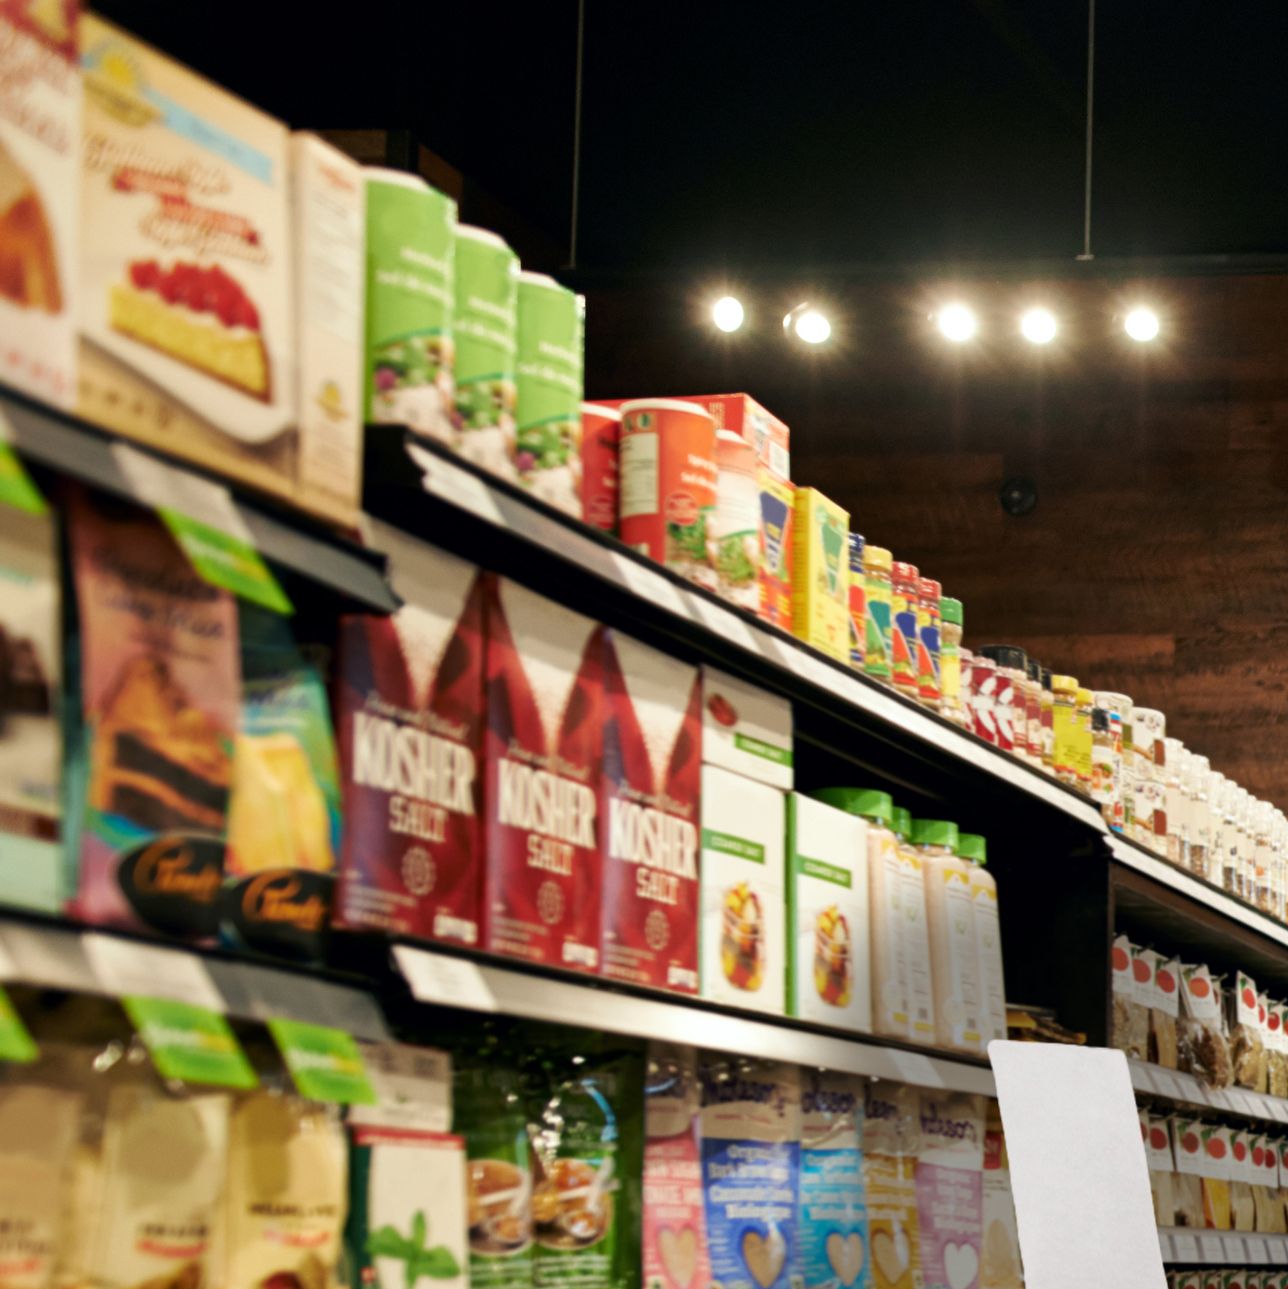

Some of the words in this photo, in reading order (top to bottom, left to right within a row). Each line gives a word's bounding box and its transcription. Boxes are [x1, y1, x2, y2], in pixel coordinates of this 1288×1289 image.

[354, 710, 475, 815] KOSHER
[389, 796, 447, 843] SALT
[499, 758, 596, 849] KOSHER
[527, 834, 575, 876] SALT
[609, 797, 697, 881] KOSHER
[636, 867, 678, 905] SALT
